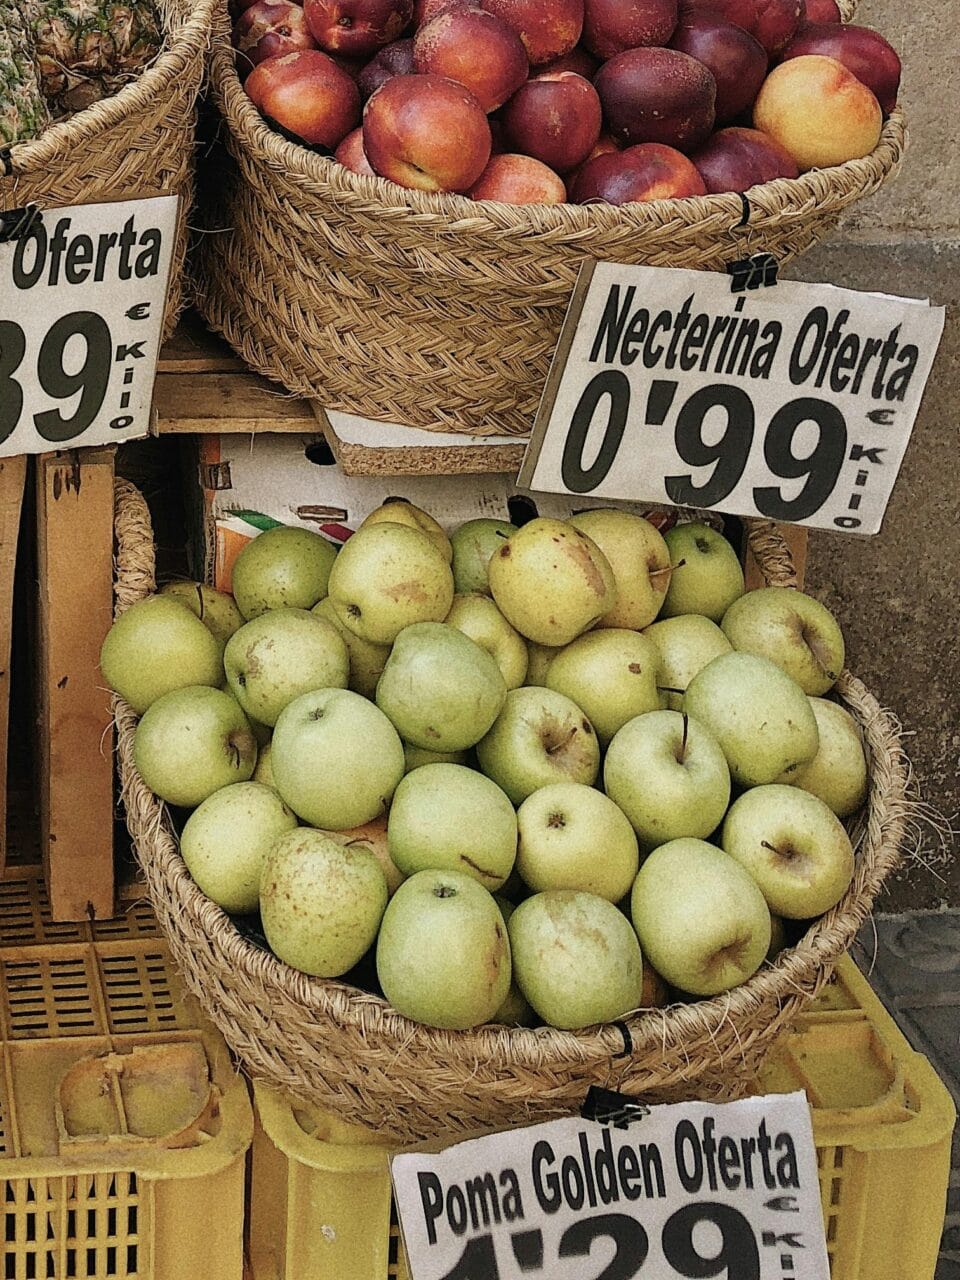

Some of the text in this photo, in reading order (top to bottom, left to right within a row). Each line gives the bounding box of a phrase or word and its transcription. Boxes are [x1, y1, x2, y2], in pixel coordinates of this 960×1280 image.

[12, 214, 163, 290] Oferta
[109, 340, 148, 430] Kilo
[589, 284, 920, 402] Necterina Oferta
[560, 369, 848, 522] 0'99
[832, 444, 886, 530] Kilo
[417, 1116, 800, 1246] Poma Golden Oferta
[761, 1230, 806, 1280] Ki
